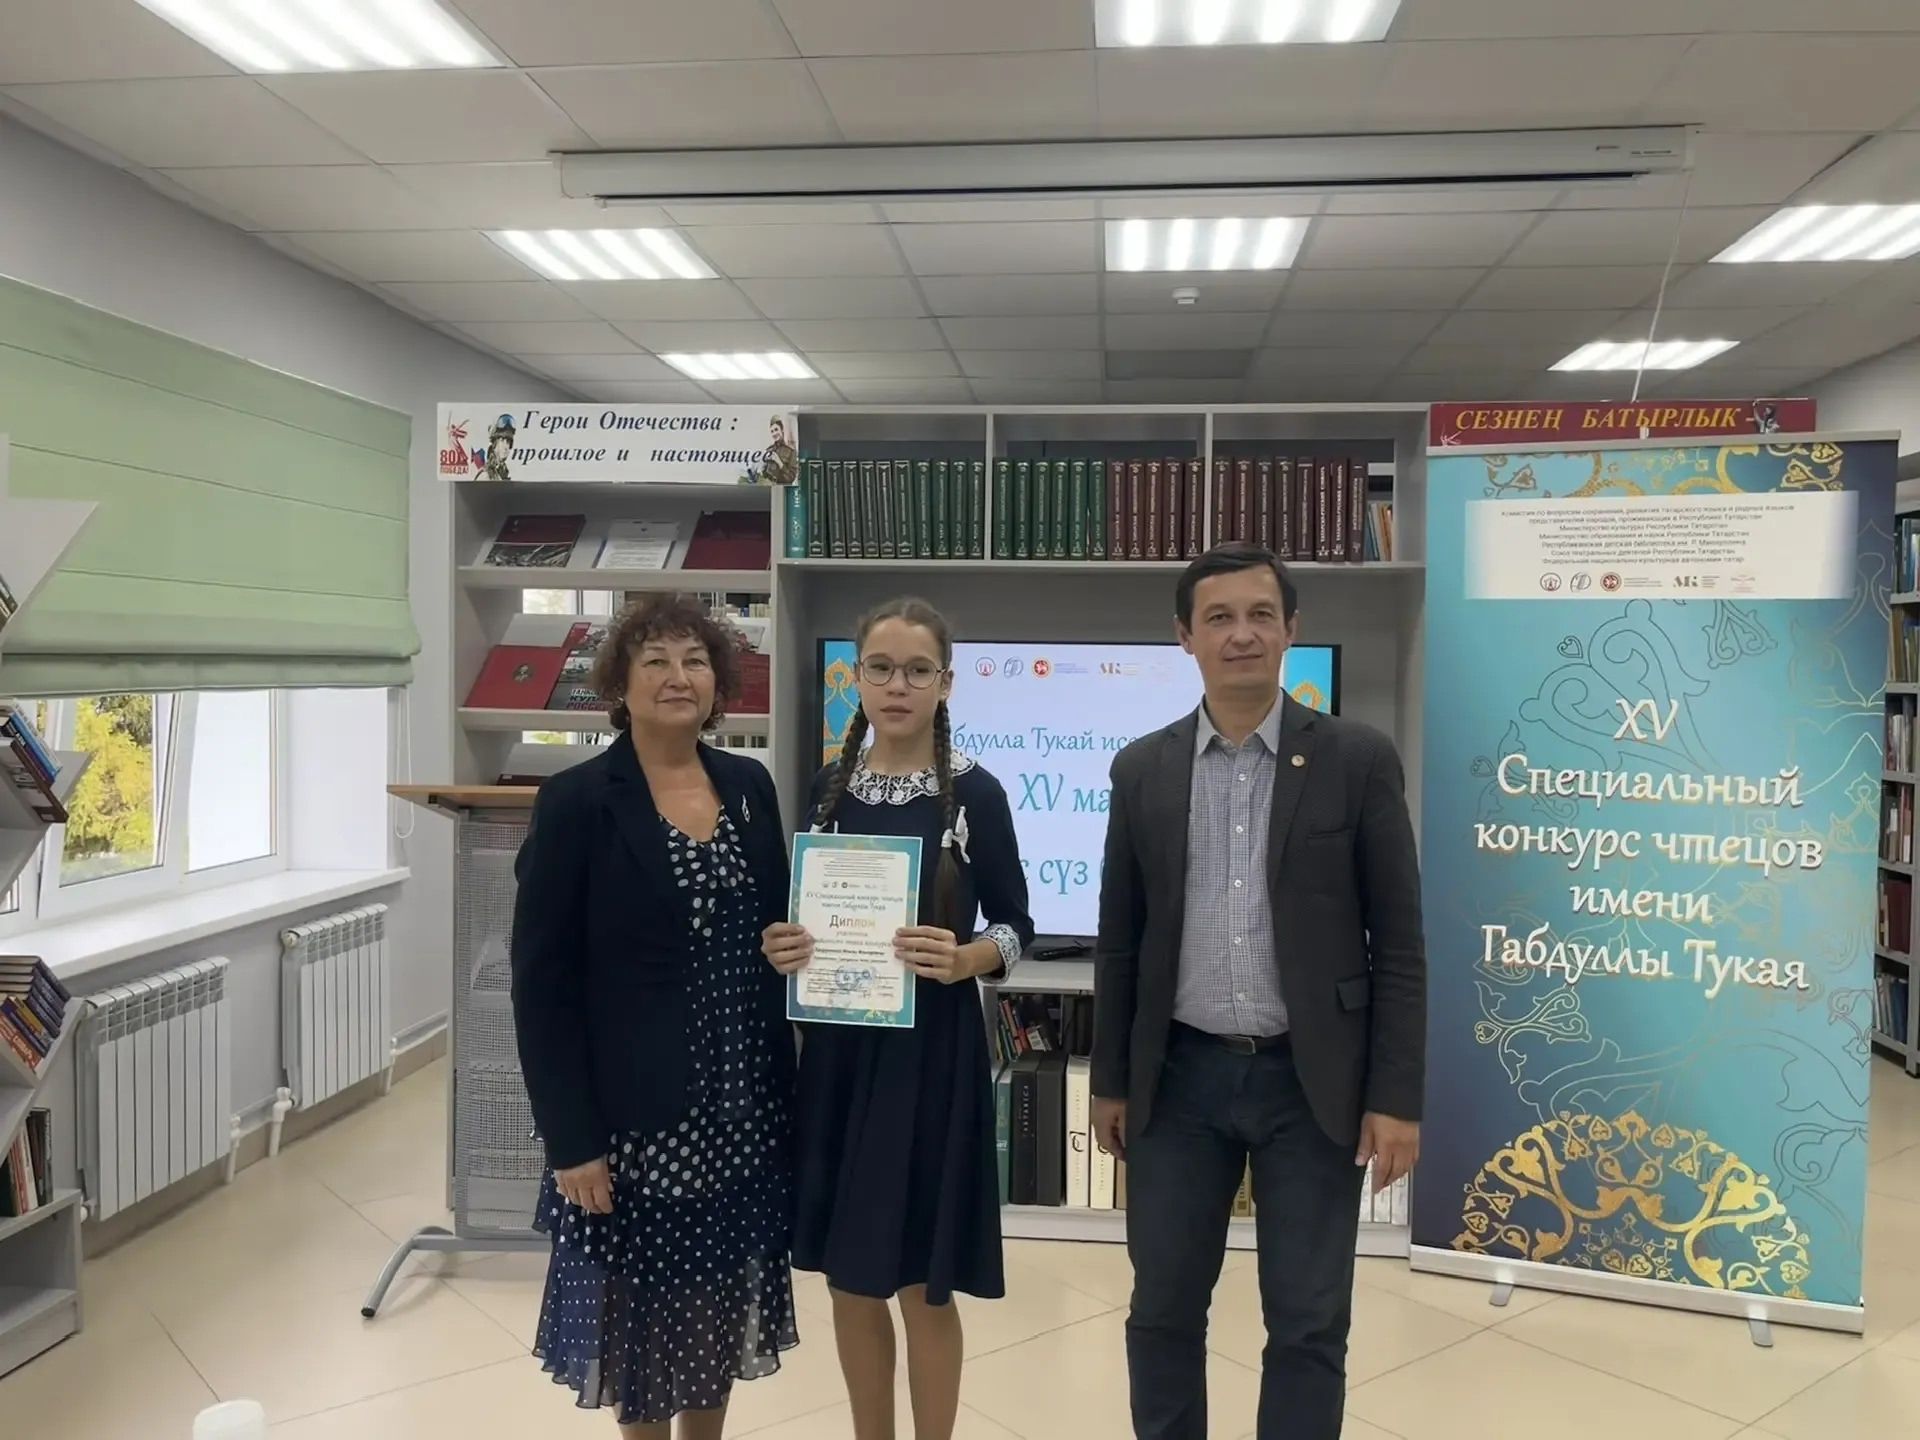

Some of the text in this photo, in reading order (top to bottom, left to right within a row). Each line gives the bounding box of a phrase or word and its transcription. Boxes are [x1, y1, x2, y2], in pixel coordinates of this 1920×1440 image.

[523, 410, 588, 432] Герои
[599, 410, 722, 432] Отечества
[1455, 408, 1563, 431] СЕЗНЕҢ
[1581, 406, 1742, 430] БАТЫРЛЫК
[511, 445, 773, 466] прошлое и настоящее
[1614, 698, 1679, 740] XV
[953, 722, 1025, 756] бдулла
[1031, 727, 1095, 758] Тукай
[1017, 772, 1111, 813] XV ма
[1497, 754, 1804, 809] Специальный
[1474, 822, 1824, 878] конкурс чтецов
[1039, 859, 1088, 895] сүз
[829, 914, 876, 929] Диплом
[1569, 884, 1714, 924] имени
[1481, 921, 1810, 1000] Габдуллы Тукая
